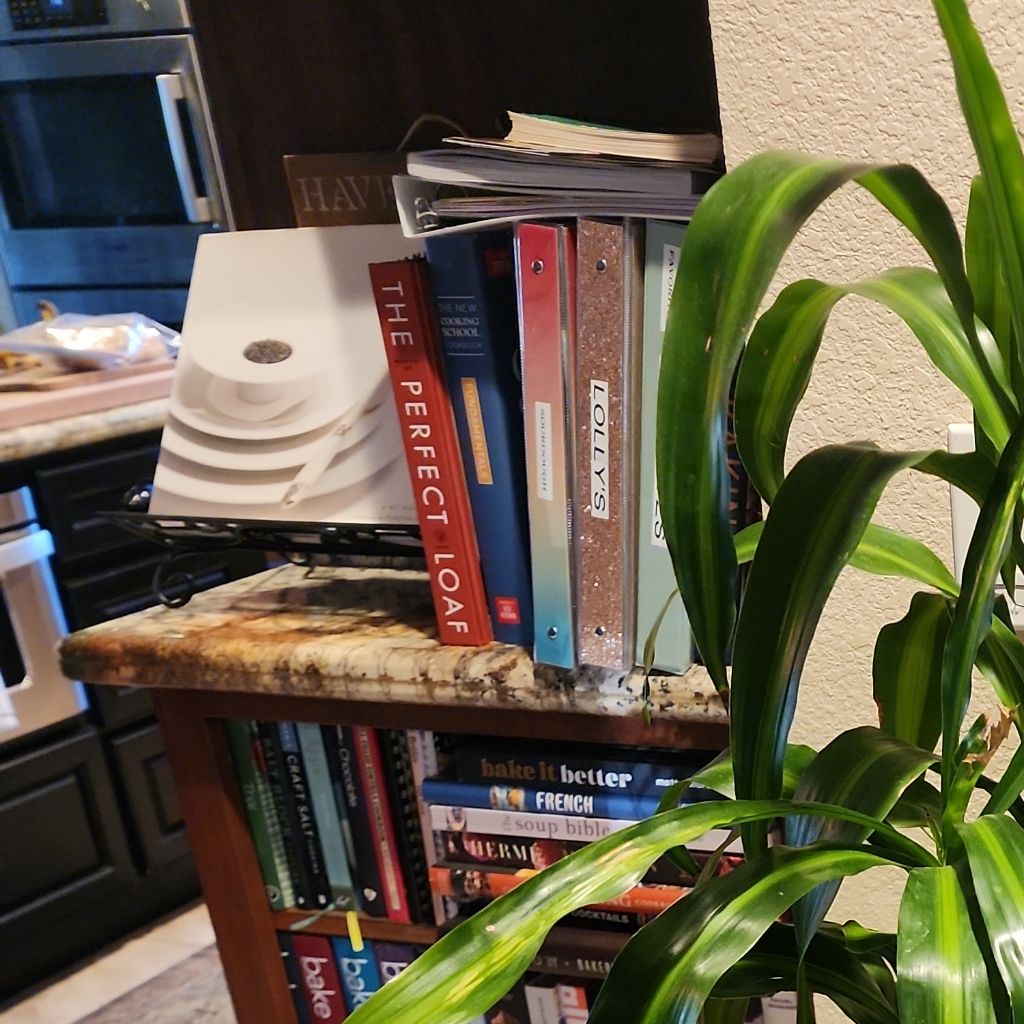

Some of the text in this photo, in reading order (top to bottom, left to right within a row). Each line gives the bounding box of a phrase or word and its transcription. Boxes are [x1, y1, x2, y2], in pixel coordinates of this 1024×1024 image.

[441, 317, 480, 326] COOKING
[442, 327, 481, 337] SCHOOL
[464, 382, 489, 480] FUNDAMENTALS
[593, 384, 606, 513] LOLLY'S
[382, 281, 413, 346] THE
[401, 381, 449, 525] PERFECT
[434, 553, 469, 634] LOAF
[286, 754, 305, 796] CRAFT
[298, 805, 314, 837] SALT
[480, 758, 536, 781] bake
[538, 761, 557, 782] it
[560, 764, 633, 788] better
[536, 791, 594, 814] FRENCH
[515, 819, 558, 839] soup
[566, 819, 610, 837] bible
[300, 955, 336, 1020] bake
[341, 957, 374, 1008] bak
